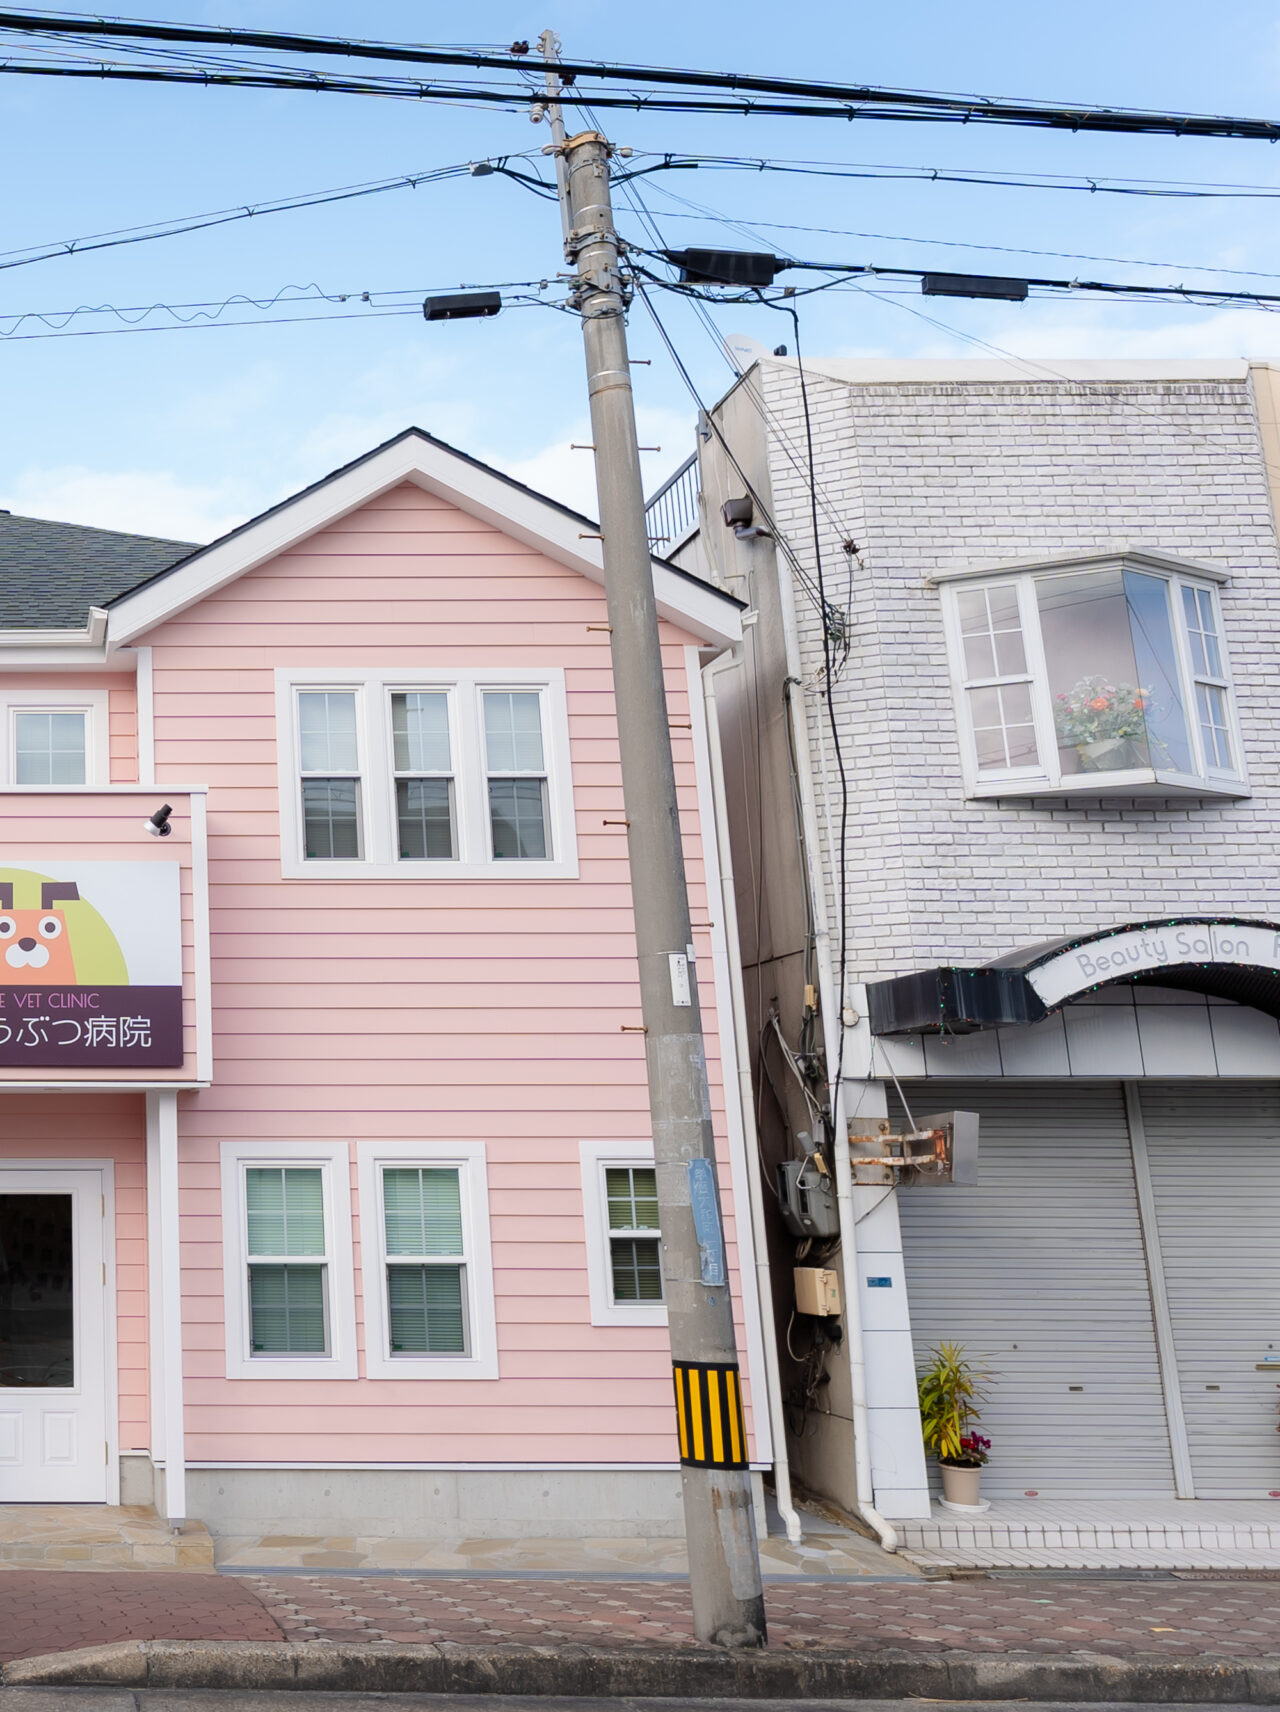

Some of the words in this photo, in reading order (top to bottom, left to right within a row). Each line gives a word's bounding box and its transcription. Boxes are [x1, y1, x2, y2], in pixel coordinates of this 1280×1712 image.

[1075, 938, 1169, 978] Beauty
[1176, 931, 1250, 957] Salon
[12, 992, 42, 1008] VET
[47, 992, 100, 1008] CLINIC
